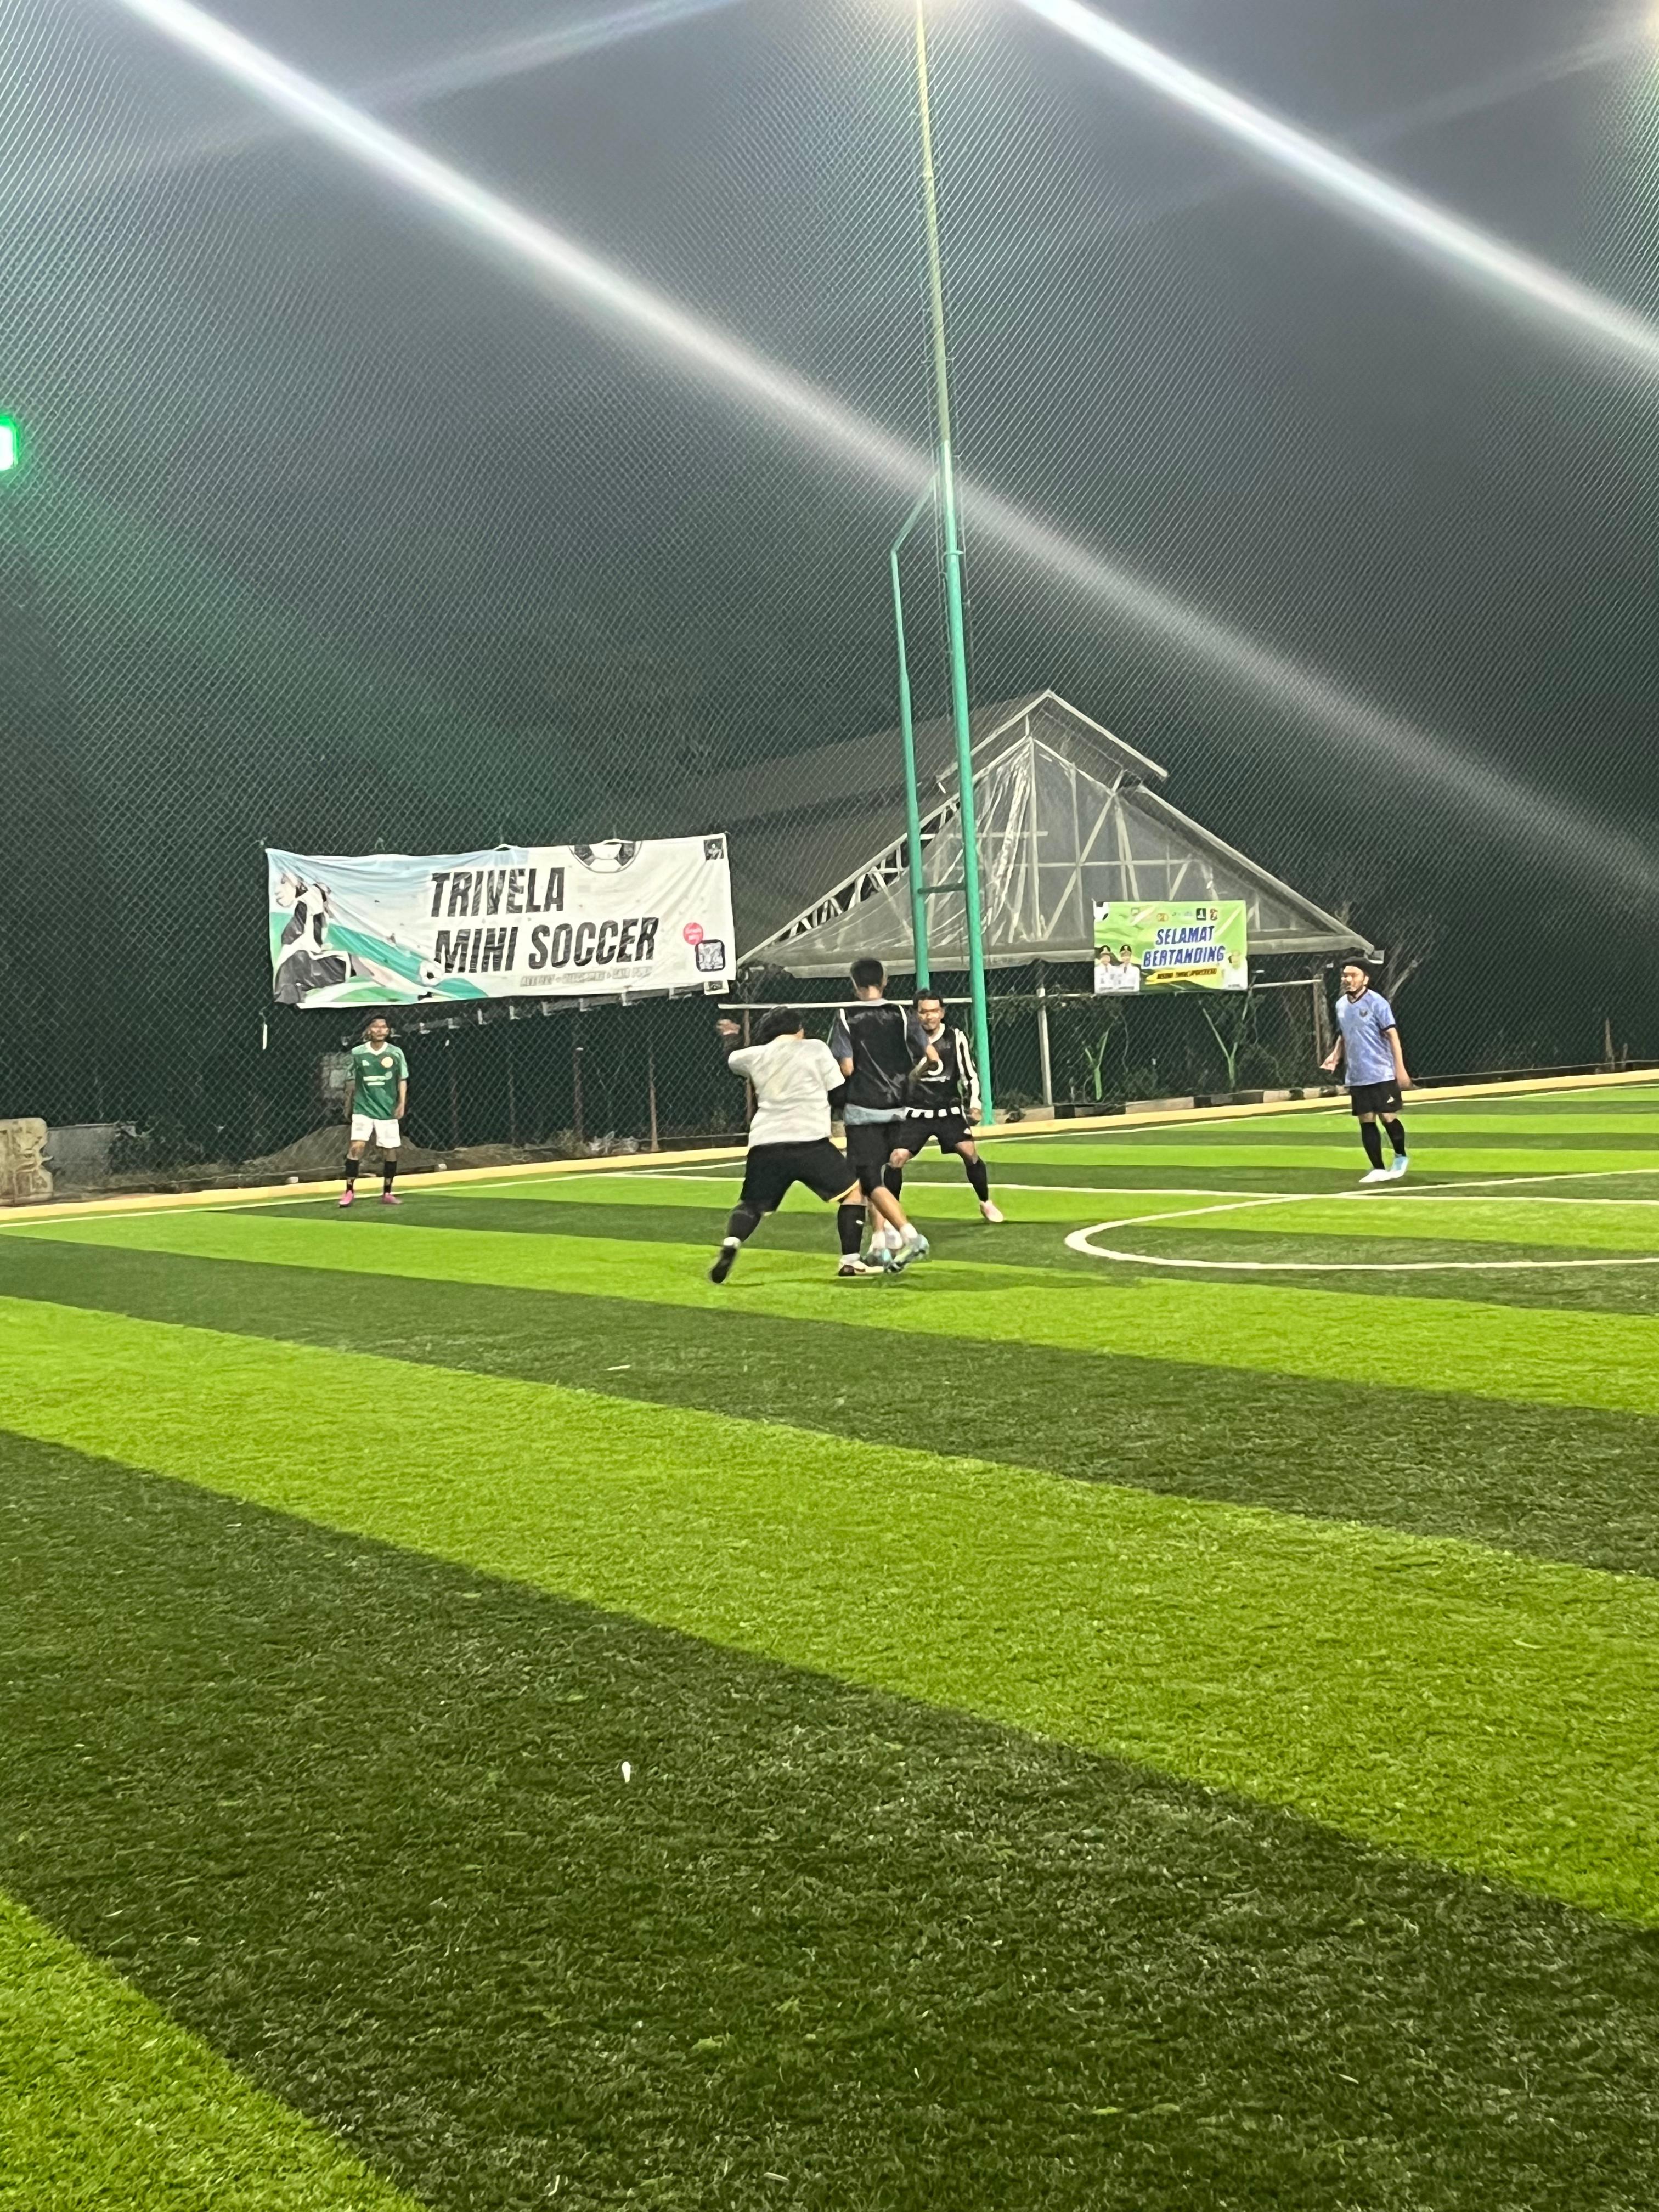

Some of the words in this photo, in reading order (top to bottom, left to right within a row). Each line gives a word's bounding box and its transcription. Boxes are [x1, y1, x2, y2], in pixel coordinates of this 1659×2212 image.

[431, 867, 565, 917] TRIVELA
[435, 927, 518, 973] MINI
[529, 917, 659, 969] SOCCER
[1155, 926, 1215, 945] SELAMAT
[1143, 945, 1226, 967] BERTANDING
